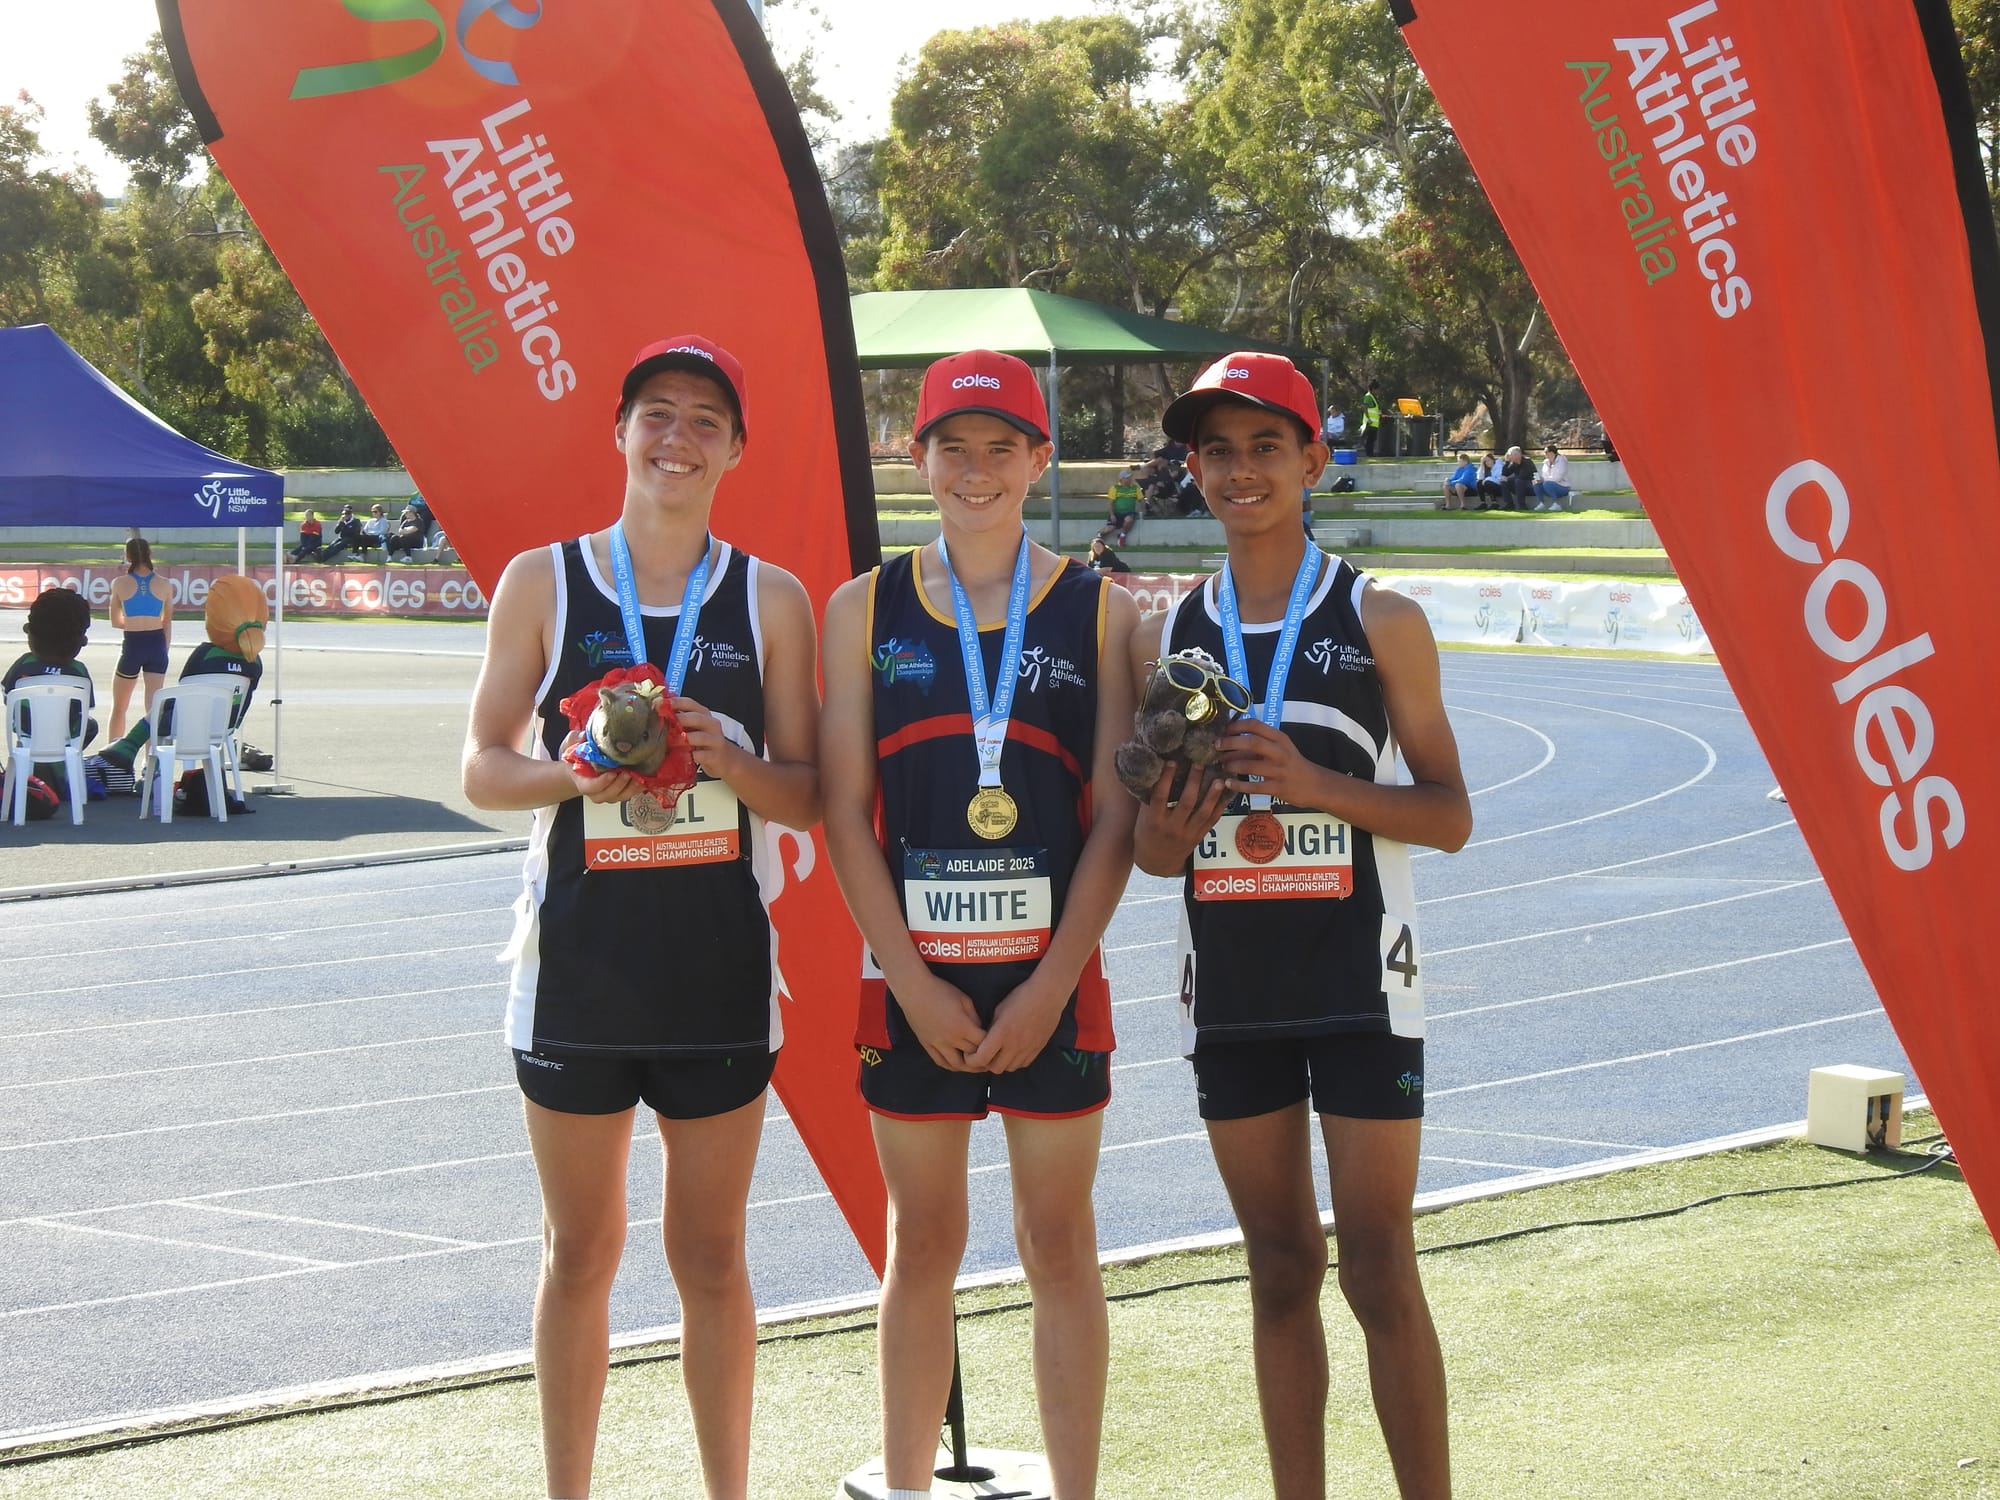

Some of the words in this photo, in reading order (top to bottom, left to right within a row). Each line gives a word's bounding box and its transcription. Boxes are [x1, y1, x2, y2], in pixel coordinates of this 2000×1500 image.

[1668, 0, 1756, 167] Little
[481, 98, 575, 256] Little
[1565, 61, 1677, 286] Australia
[1612, 37, 1752, 319] Athletics
[376, 164, 499, 376] Australia
[425, 137, 577, 401] Athletics
[952, 373, 1001, 389] coles
[228, 488, 250, 496] Little
[228, 496, 267, 505] Athletics
[228, 505, 248, 513] NSW
[341, 572, 426, 609] coles
[1294, 565, 1317, 604] Australian
[620, 581, 634, 616] Athletics
[1011, 586, 1025, 621] Athletics
[681, 600, 699, 638] Athletics
[959, 606, 974, 643] Athletics
[1288, 604, 1303, 625] Little
[1007, 620, 1020, 643] Little
[1225, 612, 1239, 649] Athletics
[1278, 625, 1297, 662] Athletics
[711, 642, 734, 652] Little
[711, 651, 750, 662] Athletics
[1229, 648, 1243, 670] Little
[1340, 645, 1360, 655] Little
[712, 660, 739, 668] Victoria
[966, 643, 984, 711] Championships
[1000, 644, 1017, 688] Australian
[1051, 657, 1074, 671] Little
[1765, 459, 1966, 871] coles
[1049, 679, 1060, 688] SA
[1267, 663, 1287, 728] Championship
[995, 688, 1009, 714] Coles
[596, 845, 650, 863] coles
[656, 842, 687, 851] AUSTRALIAN
[687, 840, 703, 849] LITTLE
[703, 837, 728, 847] ATHLETICS
[656, 846, 729, 861] CHAMPIONSHIPS
[946, 858, 1005, 873] ADELAIDE
[1009, 857, 1035, 871] 2025
[1203, 875, 1257, 894] coles
[1262, 873, 1294, 882] AUSTRALIAN
[1294, 872, 1311, 881] LITTLE
[1312, 872, 1340, 881] ATHLETICS
[1262, 881, 1340, 893] CHAMPIONSHIPS
[924, 889, 1028, 922] WHITE
[918, 939, 961, 957] coles
[967, 938, 999, 947] AUSTRALIAN
[999, 937, 1015, 946] LITTLE
[1015, 935, 1040, 945] ATHLETICS
[967, 943, 1039, 958] CHAMPIONSHIPS
[1386, 923, 1418, 989] 4
[521, 1053, 565, 1070] ENERGETIC
